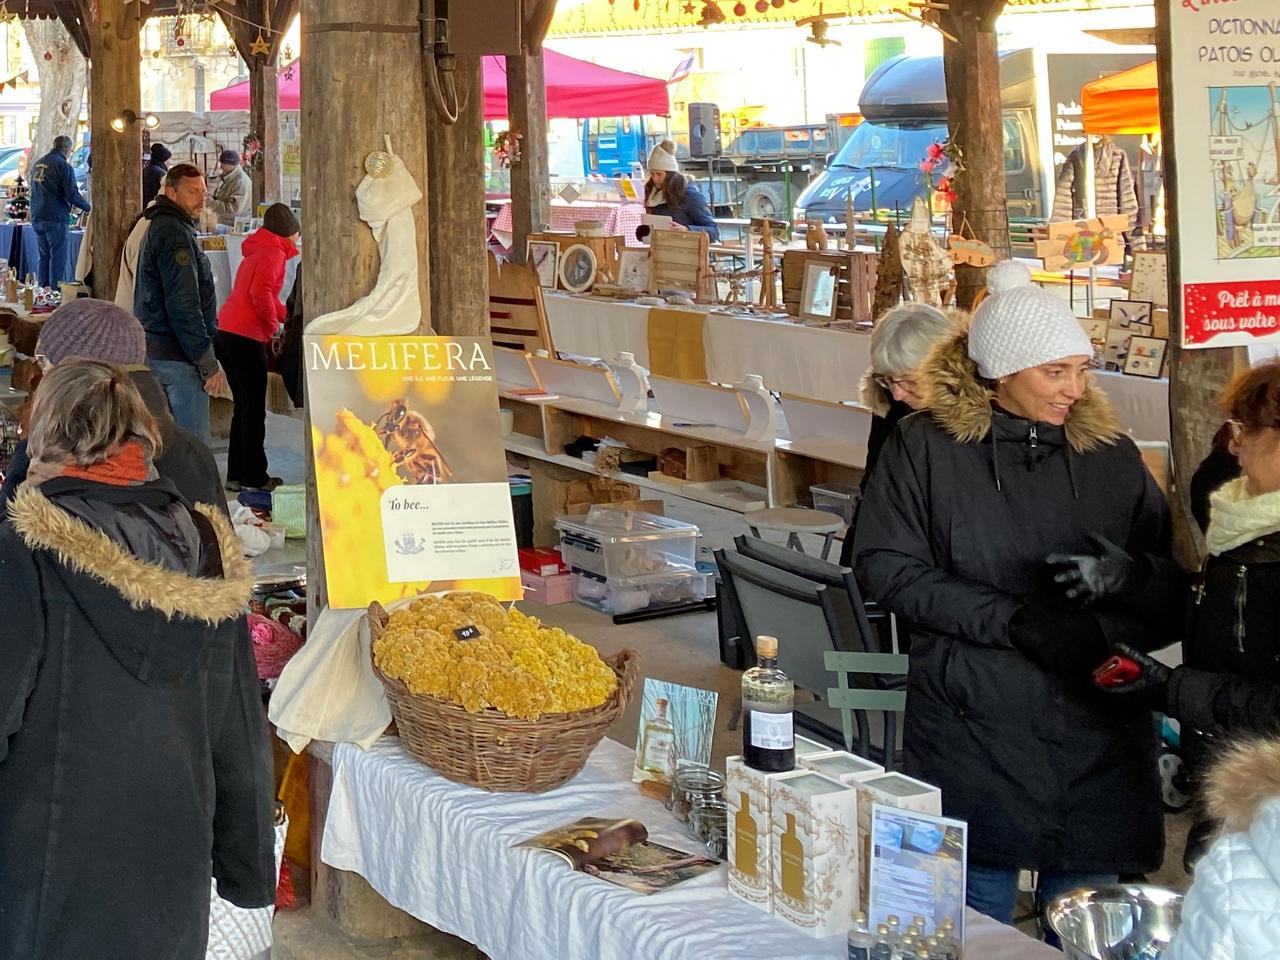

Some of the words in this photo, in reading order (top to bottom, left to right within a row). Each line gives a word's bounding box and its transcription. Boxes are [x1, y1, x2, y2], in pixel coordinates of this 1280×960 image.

[1198, 45, 1253, 63] PATOIS
[1217, 289, 1250, 309] Prêt
[1252, 290, 1263, 307] à
[1263, 293, 1280, 306] m
[1203, 316, 1238, 332] sous
[1238, 311, 1278, 330] votre
[310, 342, 492, 371] MELIFERA
[388, 498, 401, 511] To
[404, 499, 429, 511] bee...
